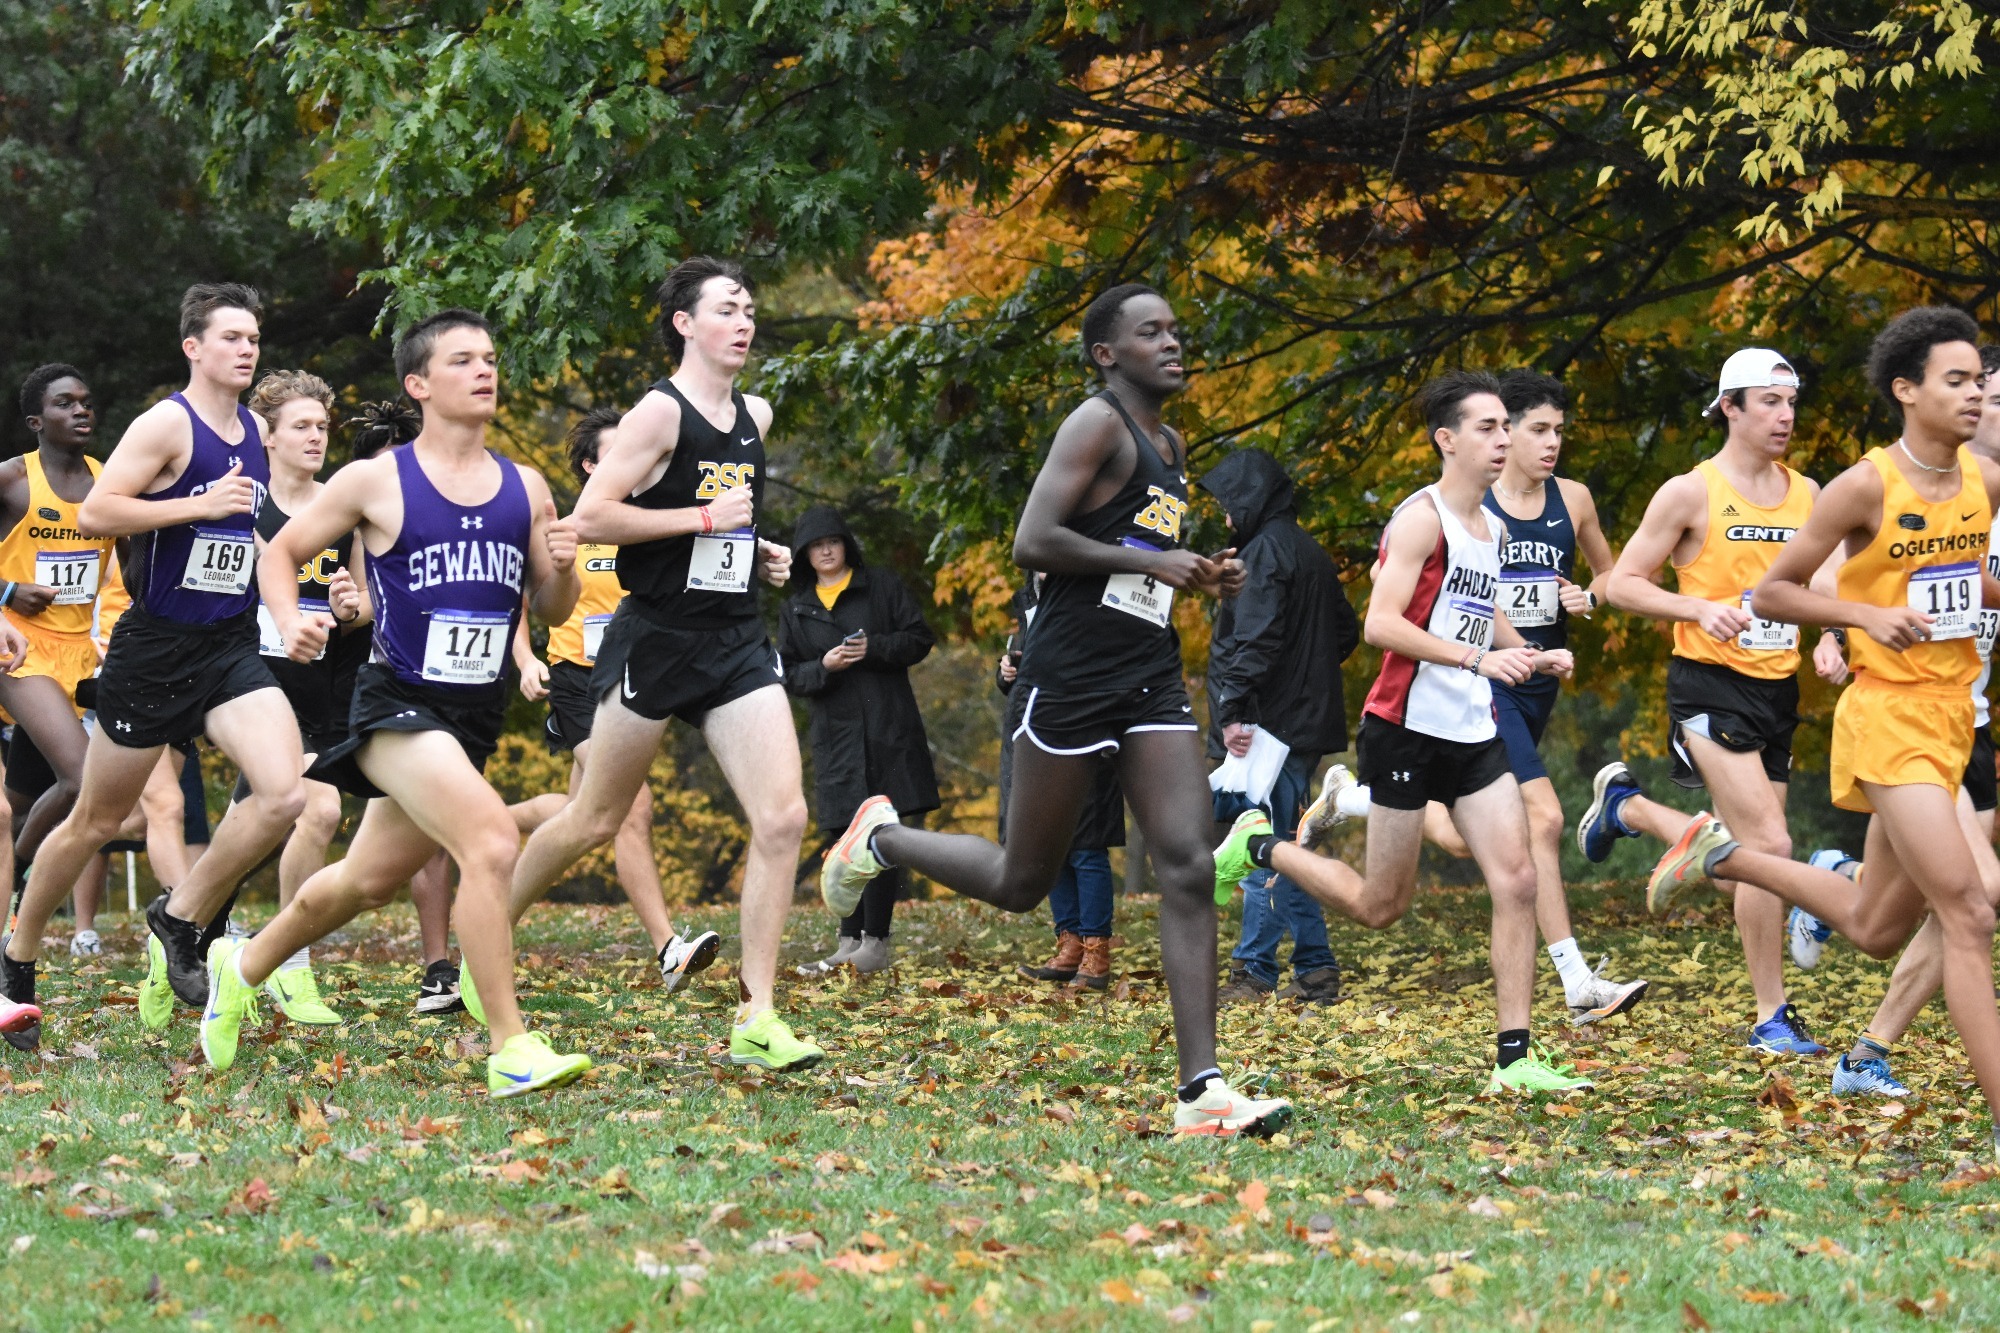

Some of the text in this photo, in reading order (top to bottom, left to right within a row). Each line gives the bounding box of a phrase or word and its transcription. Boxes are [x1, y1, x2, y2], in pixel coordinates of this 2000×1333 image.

[696, 461, 754, 499] BSC
[1133, 485, 1188, 543] BSC
[29, 526, 112, 541] OGLETH
[1726, 525, 1798, 543] CENTR
[203, 542, 246, 572] 169
[721, 542, 734, 570] 3
[50, 563, 88, 587] 117
[204, 571, 235, 583] LEONARD
[408, 541, 524, 595] SEWANEE
[714, 570, 736, 581] JONES
[1143, 576, 1156, 594] 4
[1447, 566, 1498, 602] RHOD
[1130, 590, 1159, 610] NTWARI
[1512, 585, 1540, 608] 24
[1927, 579, 1970, 614] 119
[1504, 609, 1548, 618] KLEMENTZOS
[1936, 614, 1964, 627] CASTLE
[1455, 614, 1488, 646] 208
[1763, 631, 1781, 640] KEITH
[446, 627, 492, 657] 171
[452, 660, 485, 671] RAMSEY
